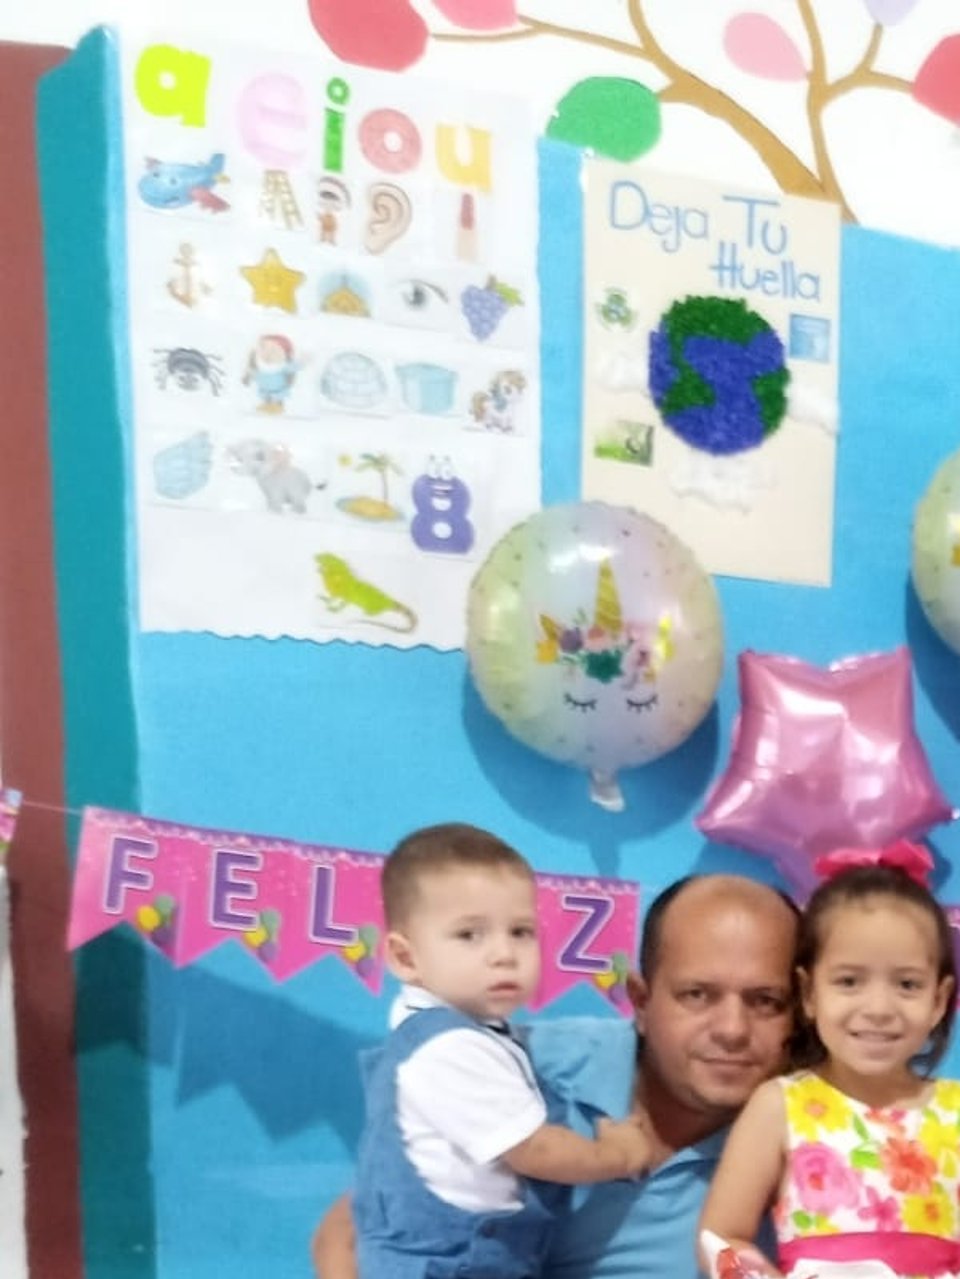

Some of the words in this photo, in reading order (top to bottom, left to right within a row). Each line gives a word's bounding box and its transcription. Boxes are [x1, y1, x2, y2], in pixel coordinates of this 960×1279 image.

[609, 180, 709, 253] Deja
[722, 194, 788, 255] Tu
[708, 240, 821, 302] Huella
